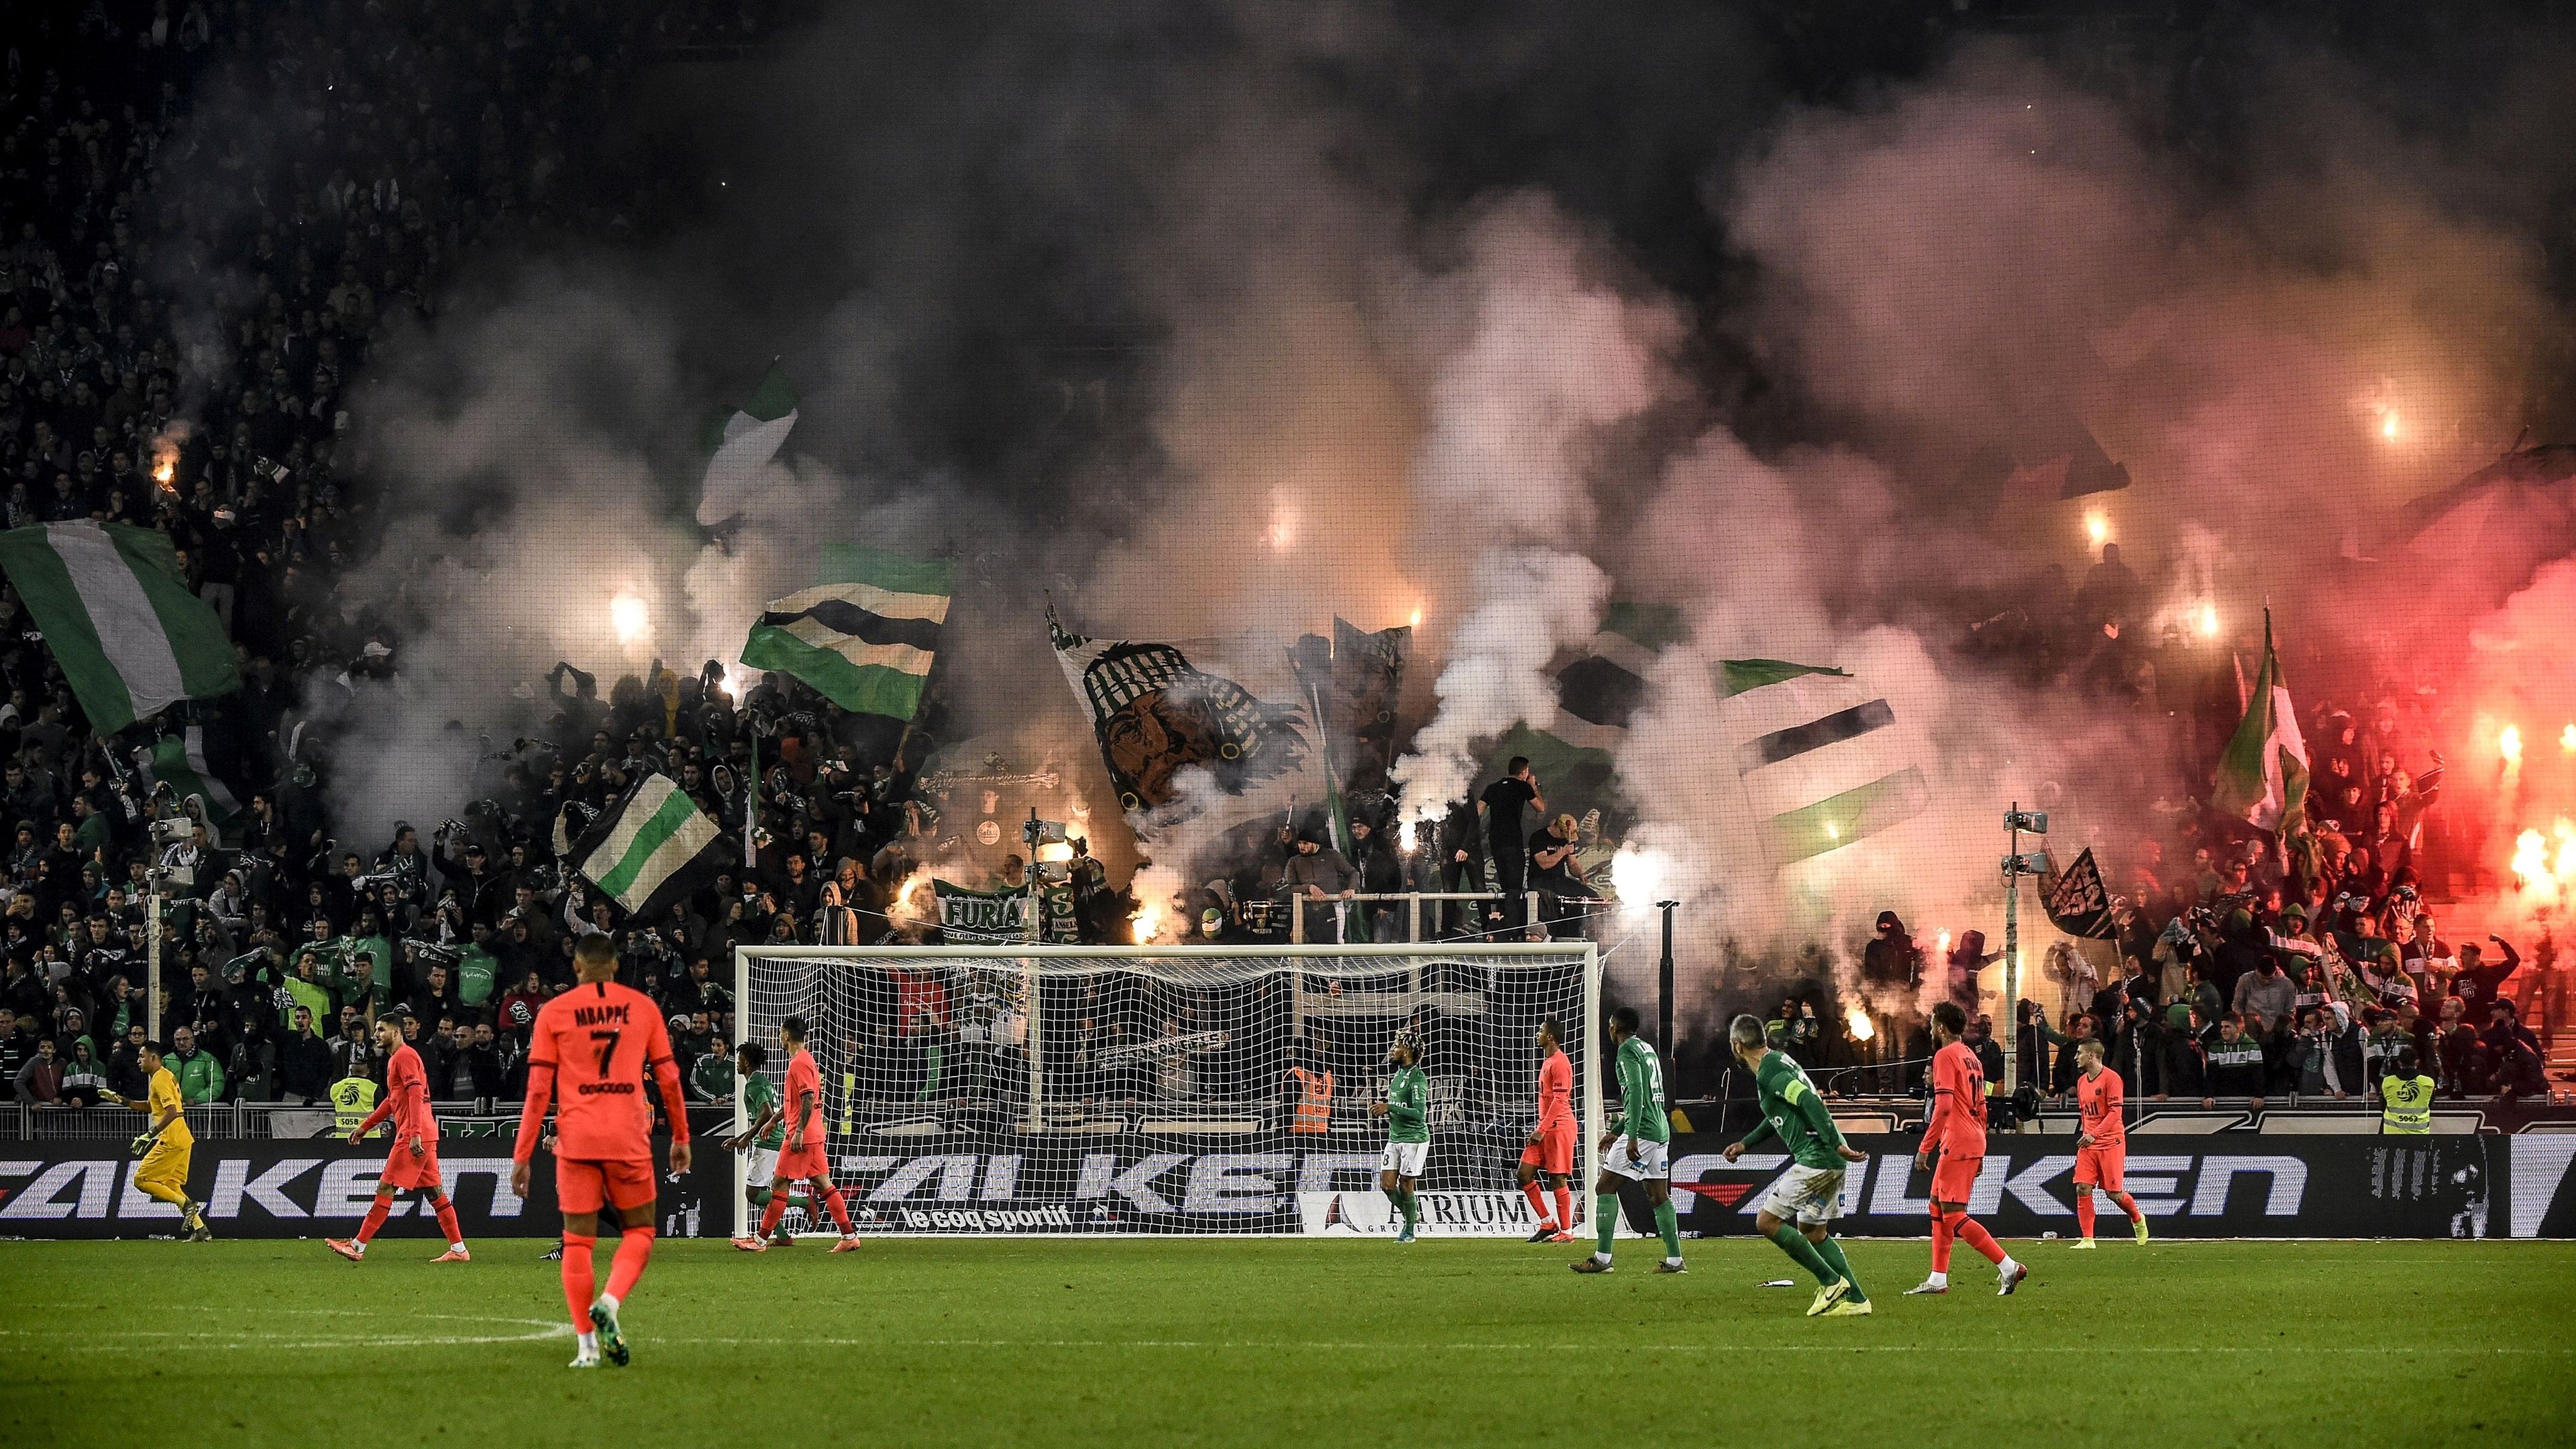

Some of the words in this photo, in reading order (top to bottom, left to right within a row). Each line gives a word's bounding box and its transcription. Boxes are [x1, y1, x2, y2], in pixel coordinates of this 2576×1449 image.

[945, 898, 1022, 930] FURIA
[574, 1002, 631, 1026] MBAPPÉ
[590, 1030, 621, 1080] 7
[901, 1207, 930, 1228] le
[931, 1210, 986, 1232] coq
[985, 1204, 1073, 1231] sportif
[1368, 1224, 1434, 1234] GROPE
